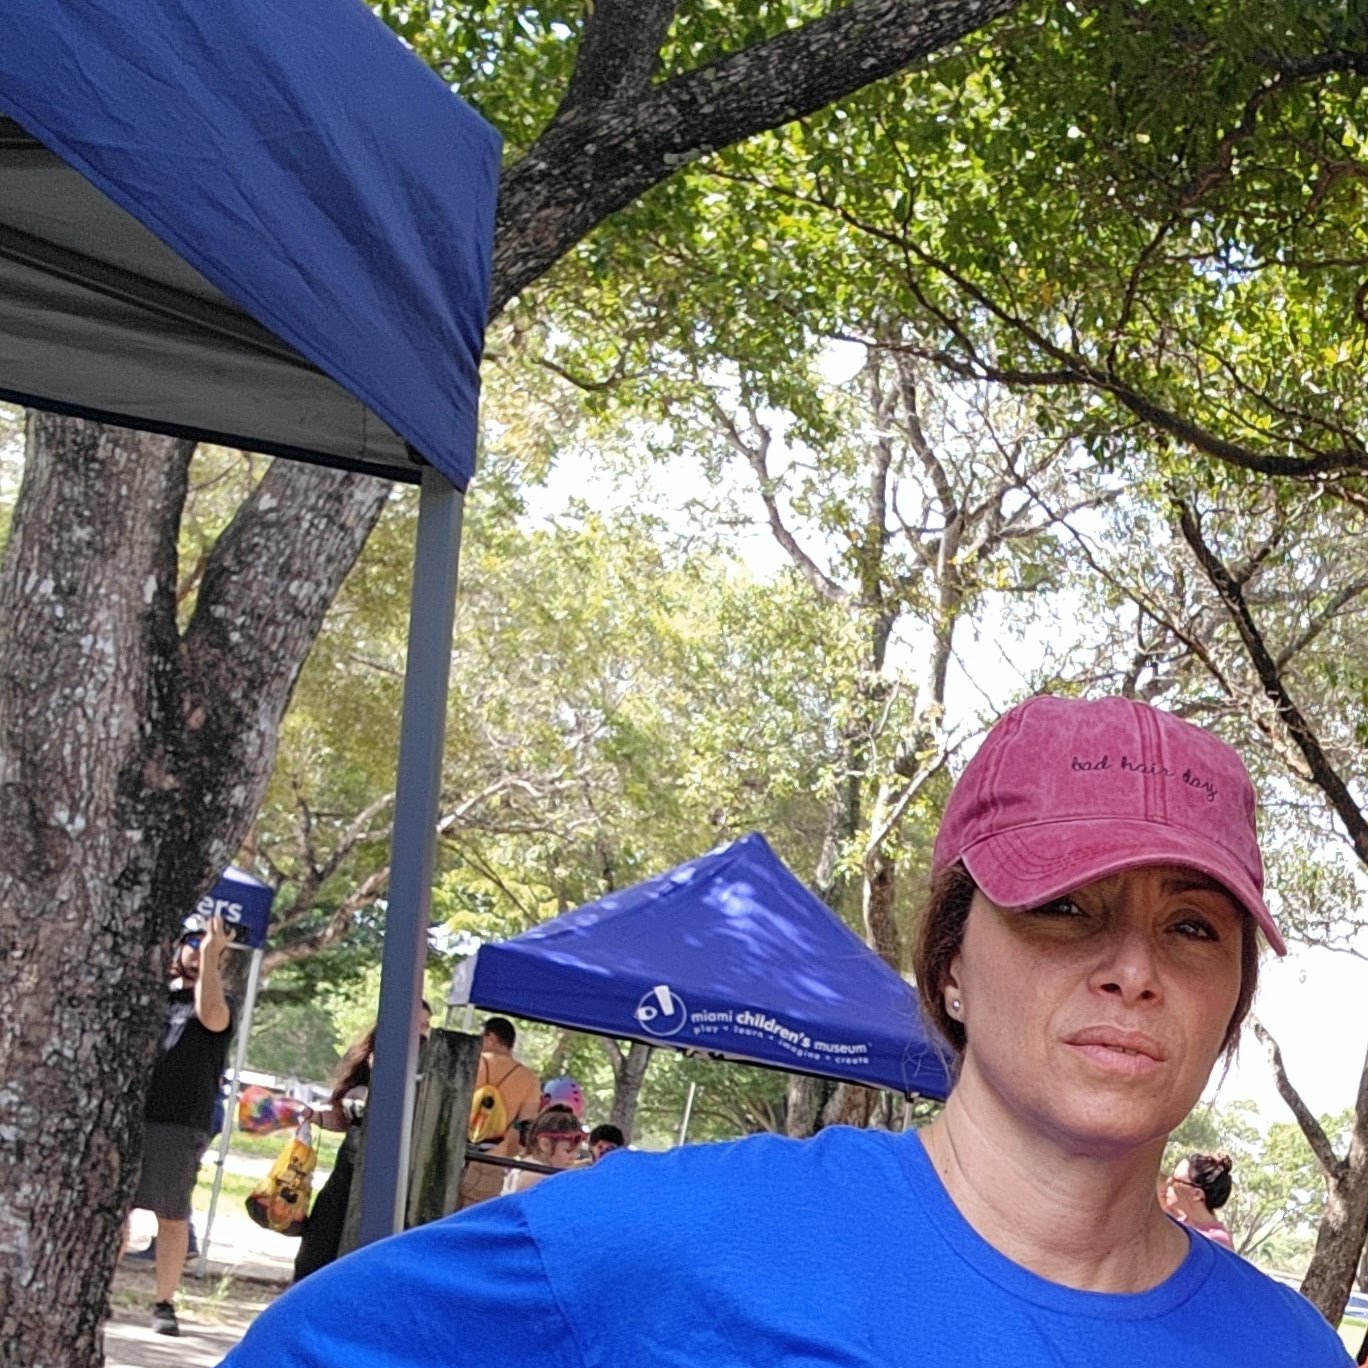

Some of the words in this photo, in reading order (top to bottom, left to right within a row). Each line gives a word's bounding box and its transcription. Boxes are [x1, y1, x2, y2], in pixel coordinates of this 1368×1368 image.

[1072, 755, 1111, 772] bad
[1121, 755, 1175, 777] hair
[1182, 768, 1218, 802] day
[196, 896, 243, 923] ers
[691, 1009, 733, 1023] miami
[736, 1010, 811, 1048] children's
[814, 1041, 867, 1055] museum
[693, 1024, 719, 1036] play
[733, 1025, 763, 1039] learn
[777, 1039, 821, 1060] imagine
[834, 1056, 869, 1065] create
